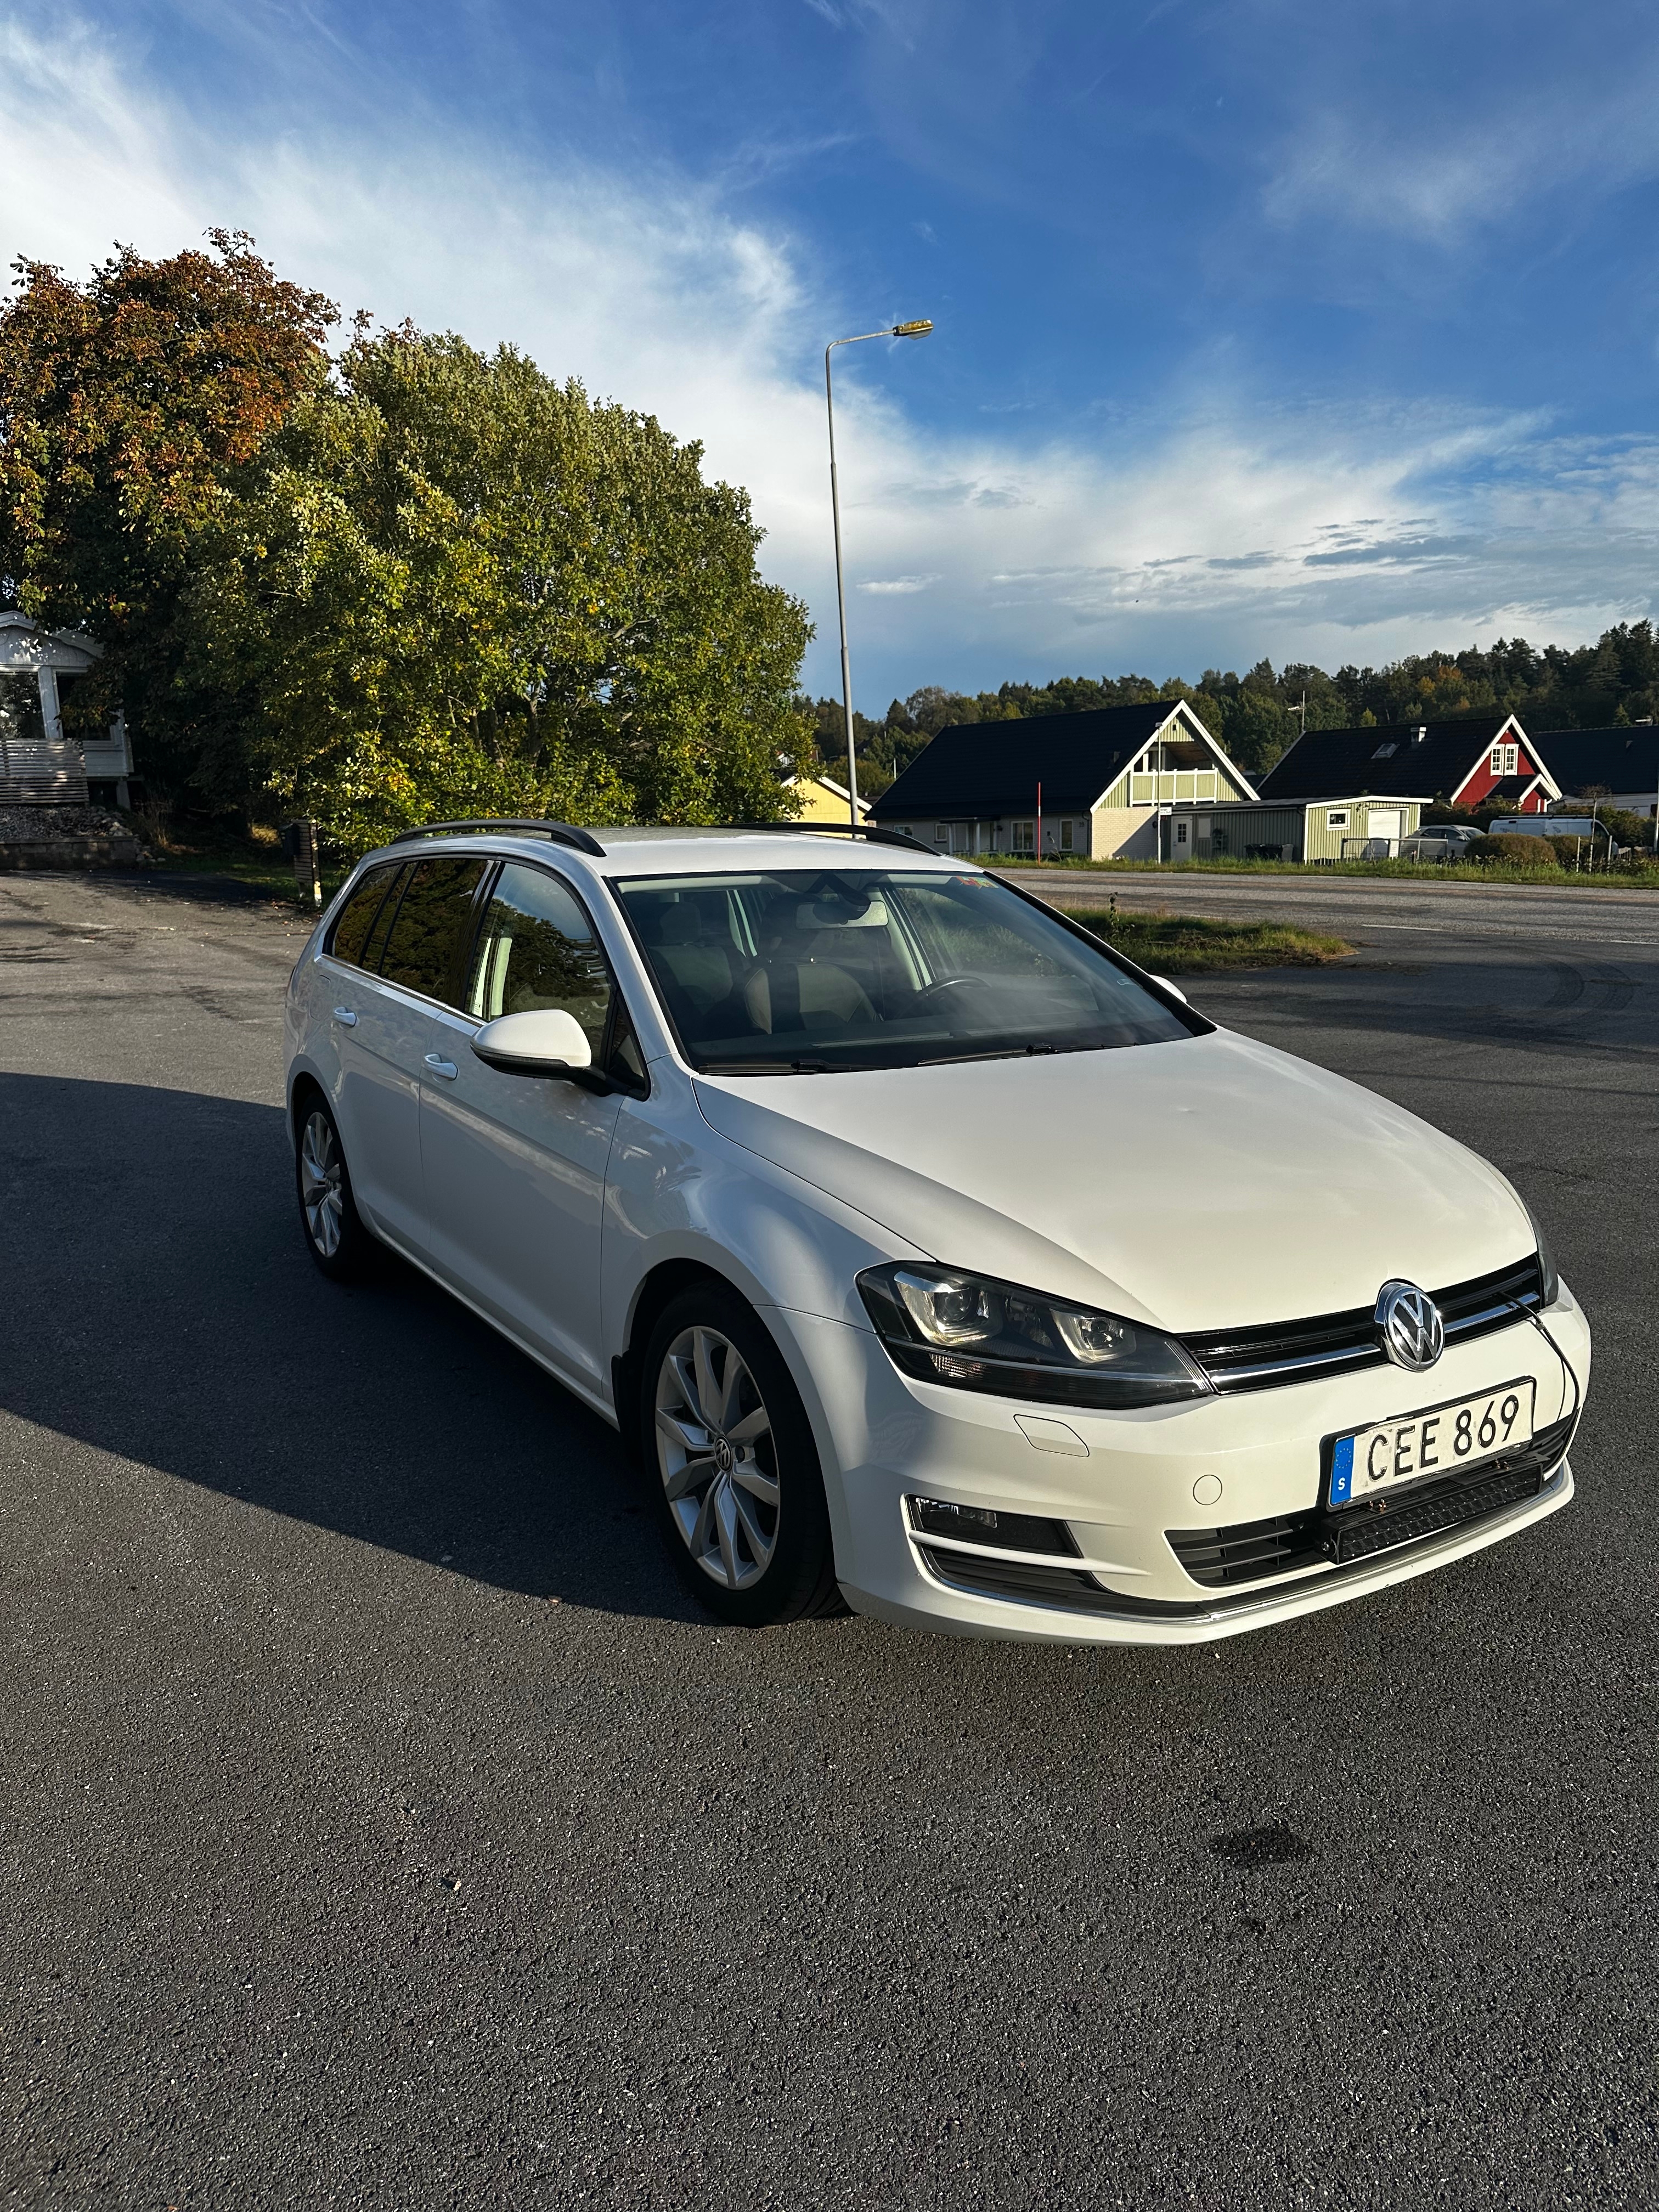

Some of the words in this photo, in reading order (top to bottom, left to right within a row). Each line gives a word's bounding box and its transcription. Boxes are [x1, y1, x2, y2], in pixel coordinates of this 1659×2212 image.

[1368, 1417, 1441, 1482] CEE
[1454, 1395, 1519, 1456] 869
[1338, 1477, 1346, 1491] S
